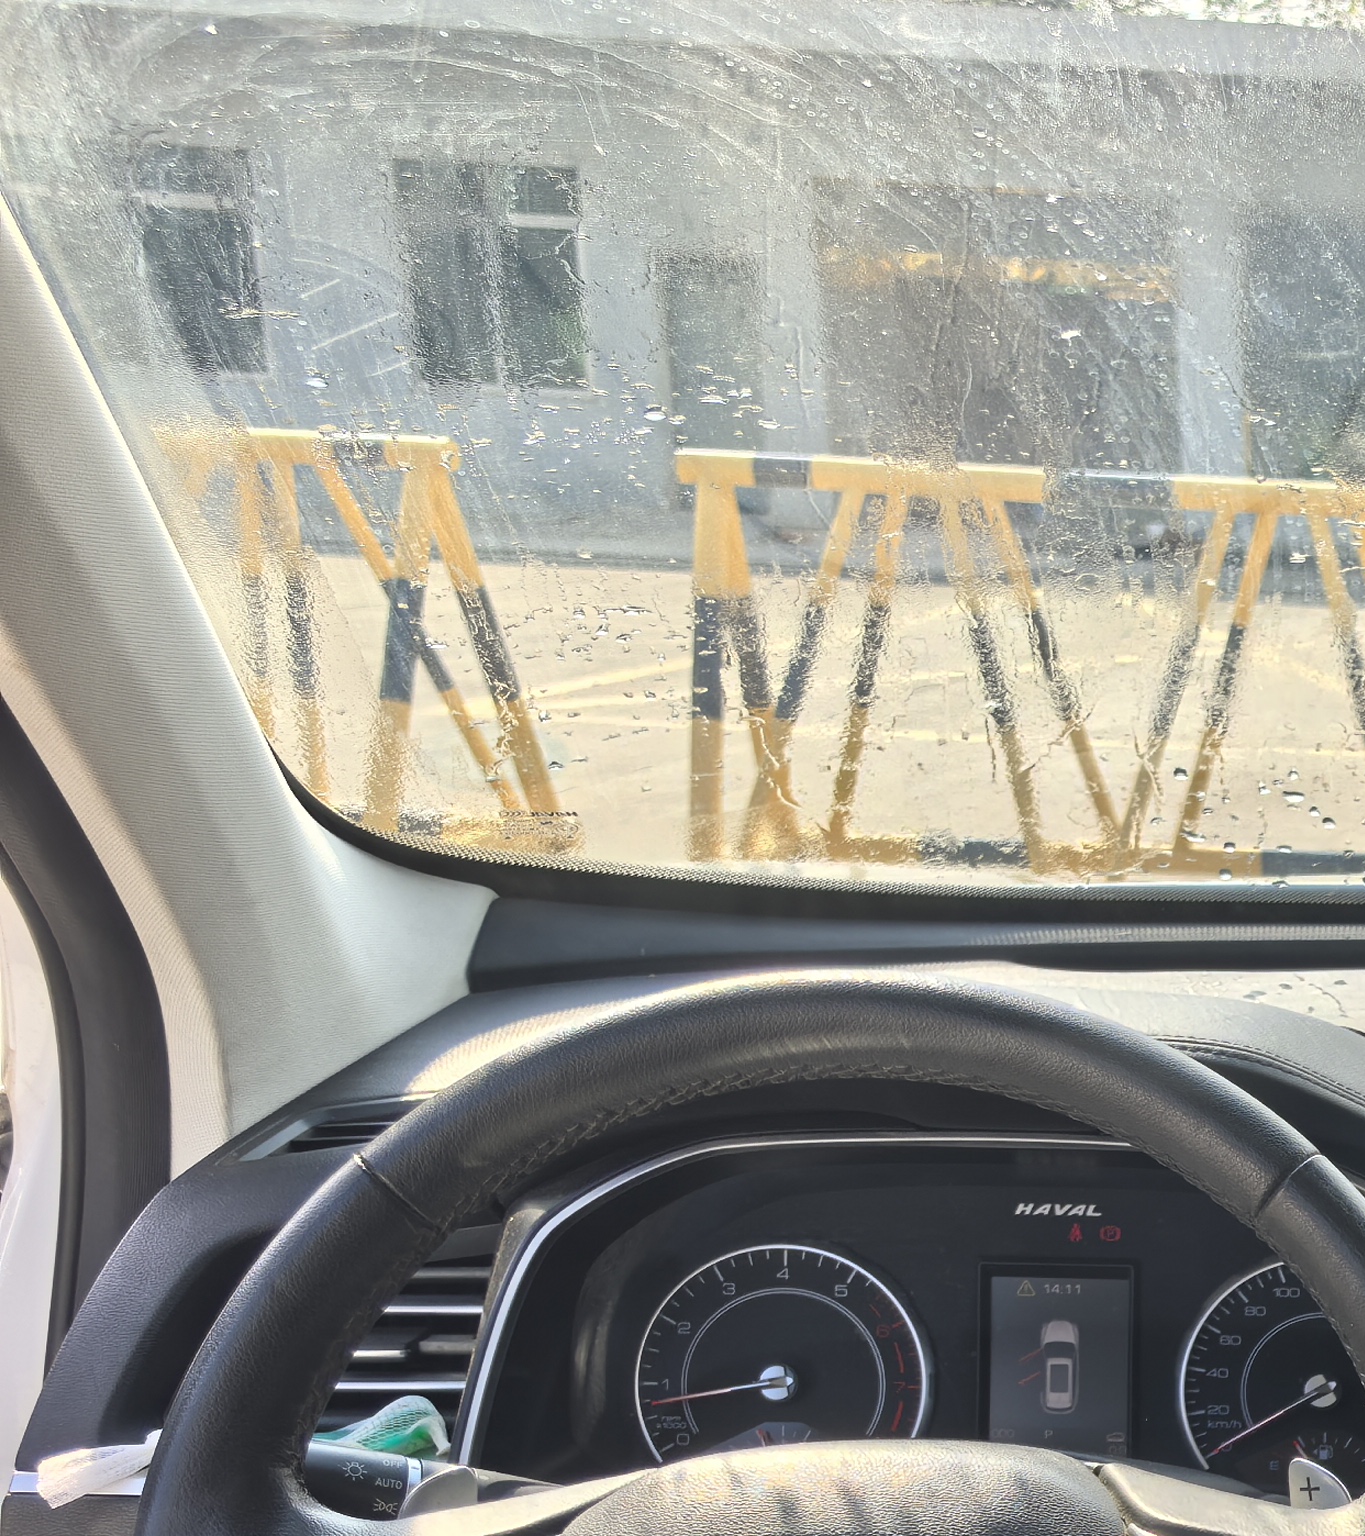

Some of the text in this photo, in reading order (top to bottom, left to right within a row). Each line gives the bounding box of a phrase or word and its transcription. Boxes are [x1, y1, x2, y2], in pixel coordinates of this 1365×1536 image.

[1014, 1203, 1102, 1217] HAVAL
[776, 1268, 790, 1280] 4
[722, 1282, 736, 1295] 3
[834, 1285, 848, 1298] 5
[1043, 1284, 1081, 1295] 14:11
[1272, 1287, 1300, 1298] 100
[1244, 1306, 1266, 1316] 80
[677, 1322, 691, 1334] 2
[876, 1325, 890, 1337] 6
[1219, 1335, 1242, 1346] 60
[1206, 1368, 1229, 1379] 40
[1207, 1405, 1230, 1415] 20
[1207, 1420, 1242, 1429] km/h
[1044, 1430, 1053, 1439] P
[375, 1478, 403, 1490] AUTO
